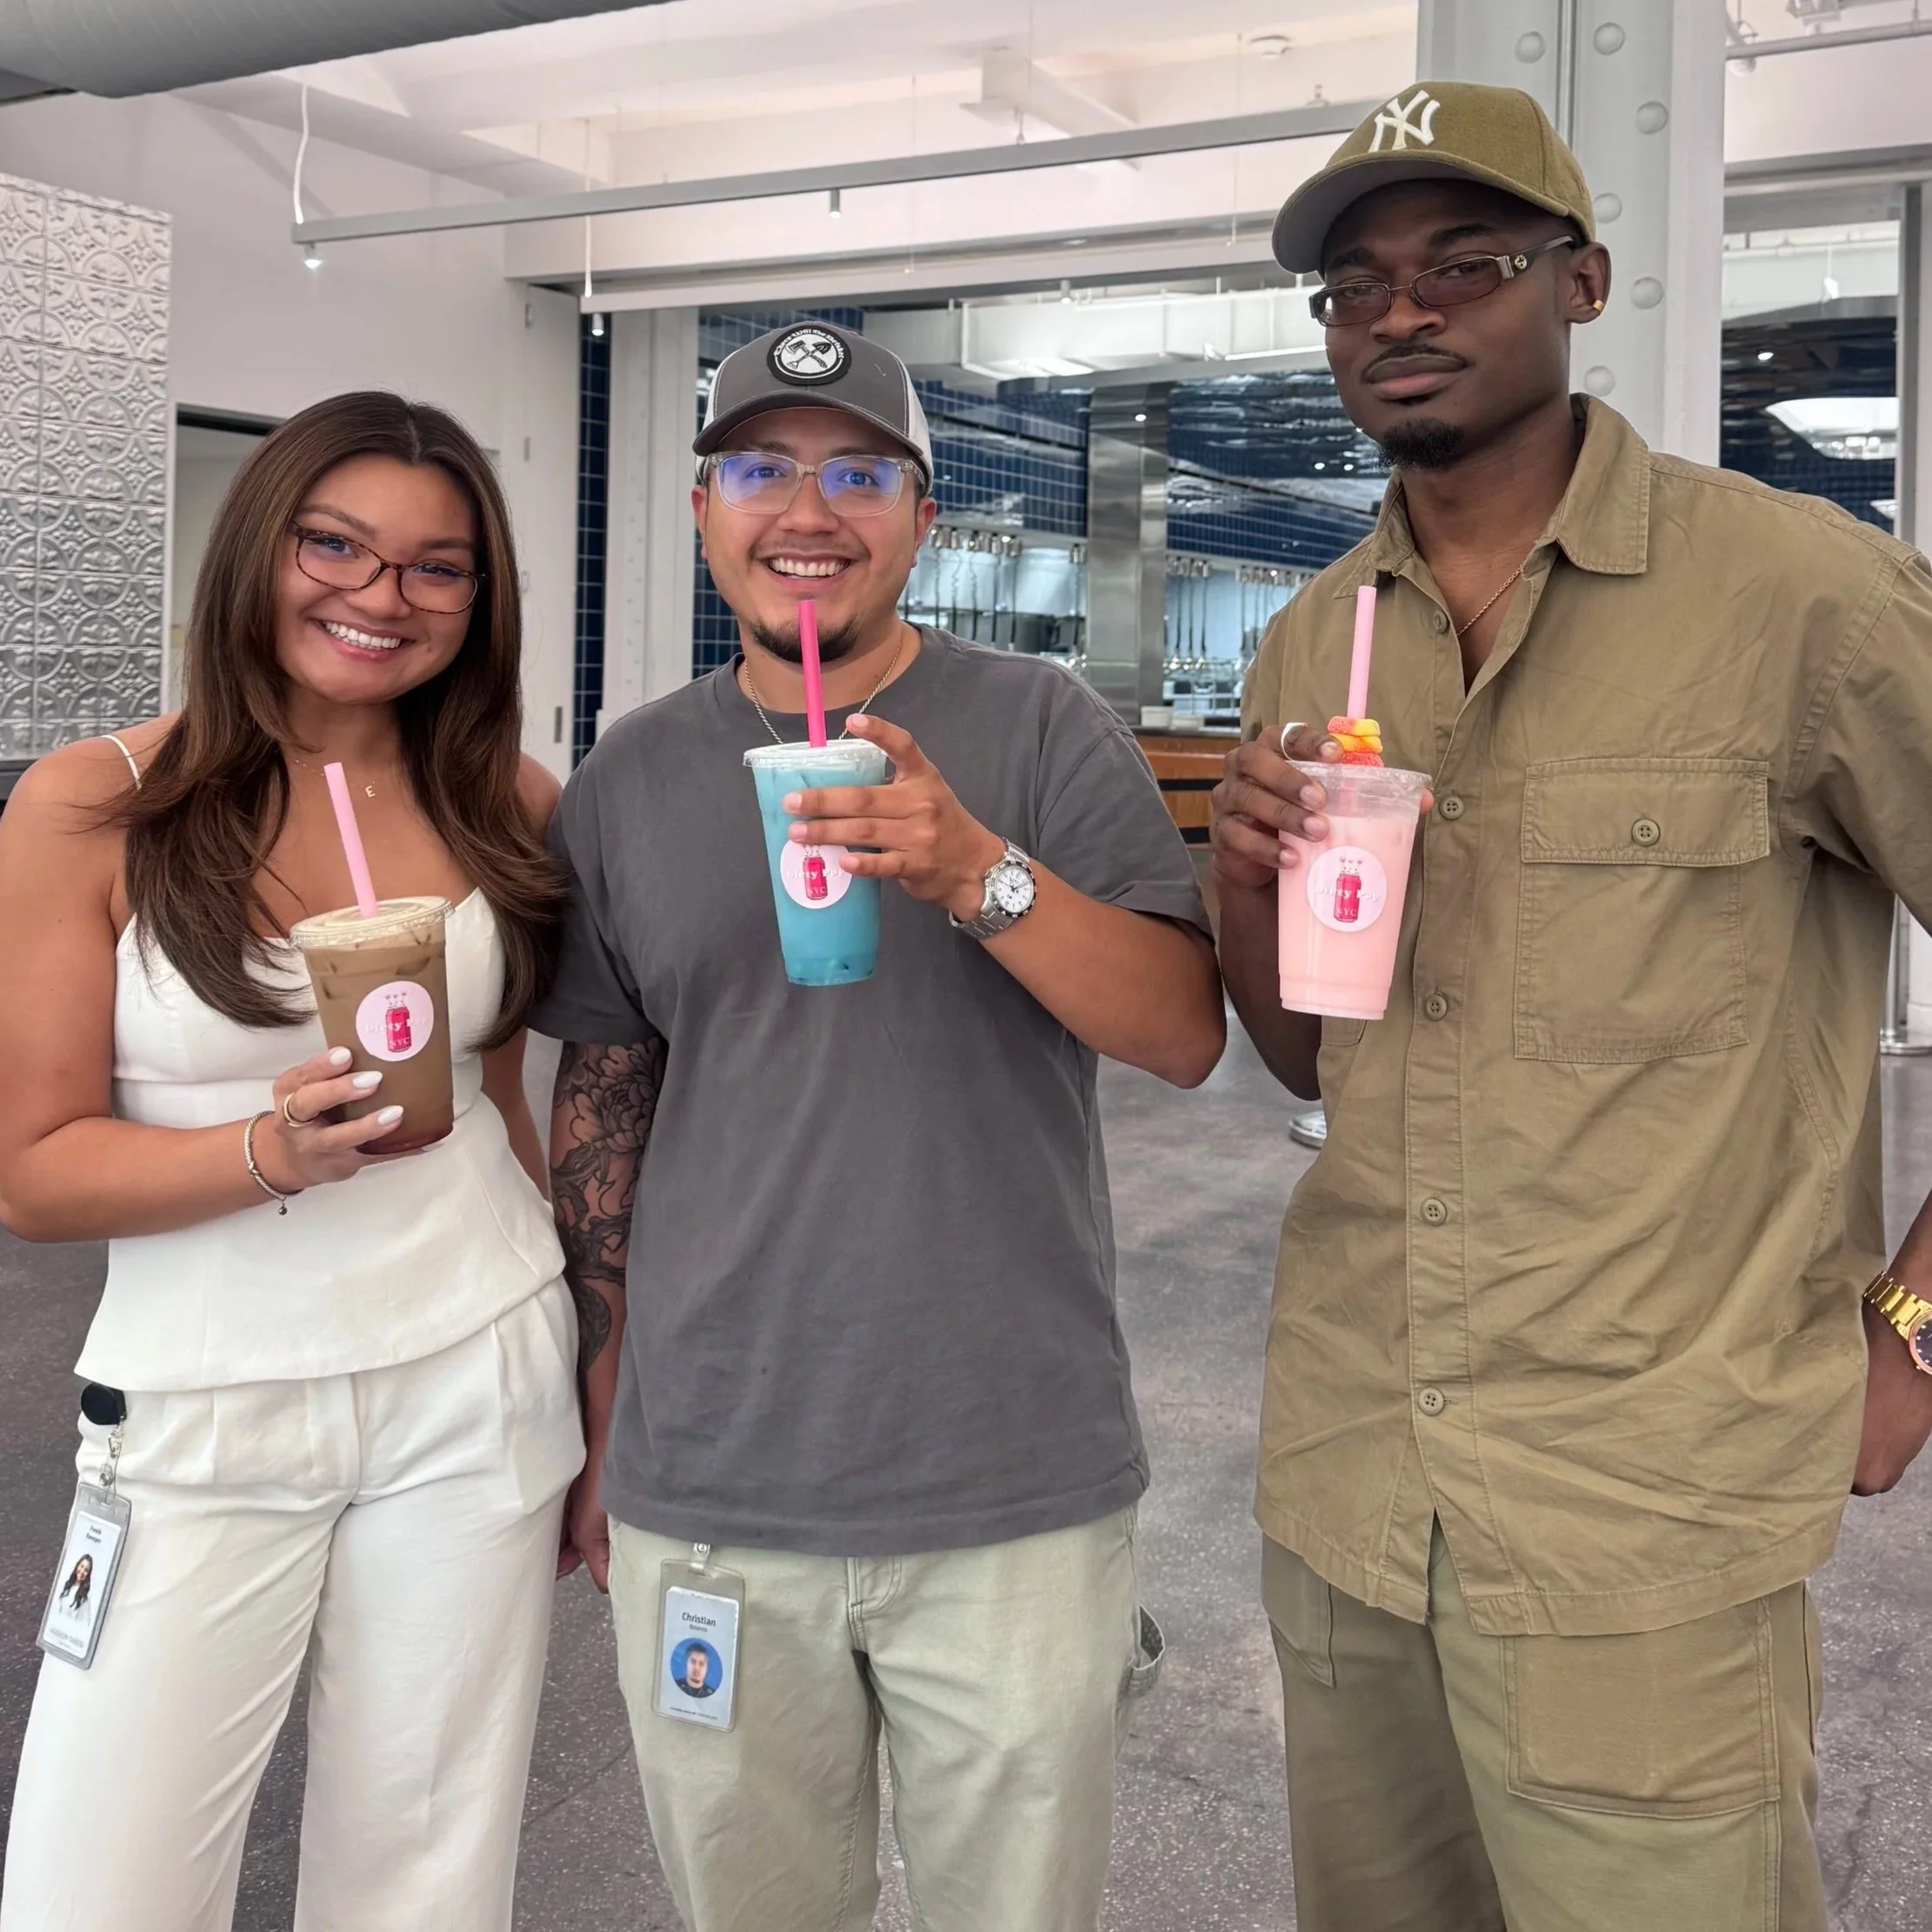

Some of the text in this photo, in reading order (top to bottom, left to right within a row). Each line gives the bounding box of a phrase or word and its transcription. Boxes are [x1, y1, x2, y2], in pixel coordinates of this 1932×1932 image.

[1368, 90, 1441, 152] NY
[365, 785, 376, 798] E
[682, 1611, 716, 1627] Christian
